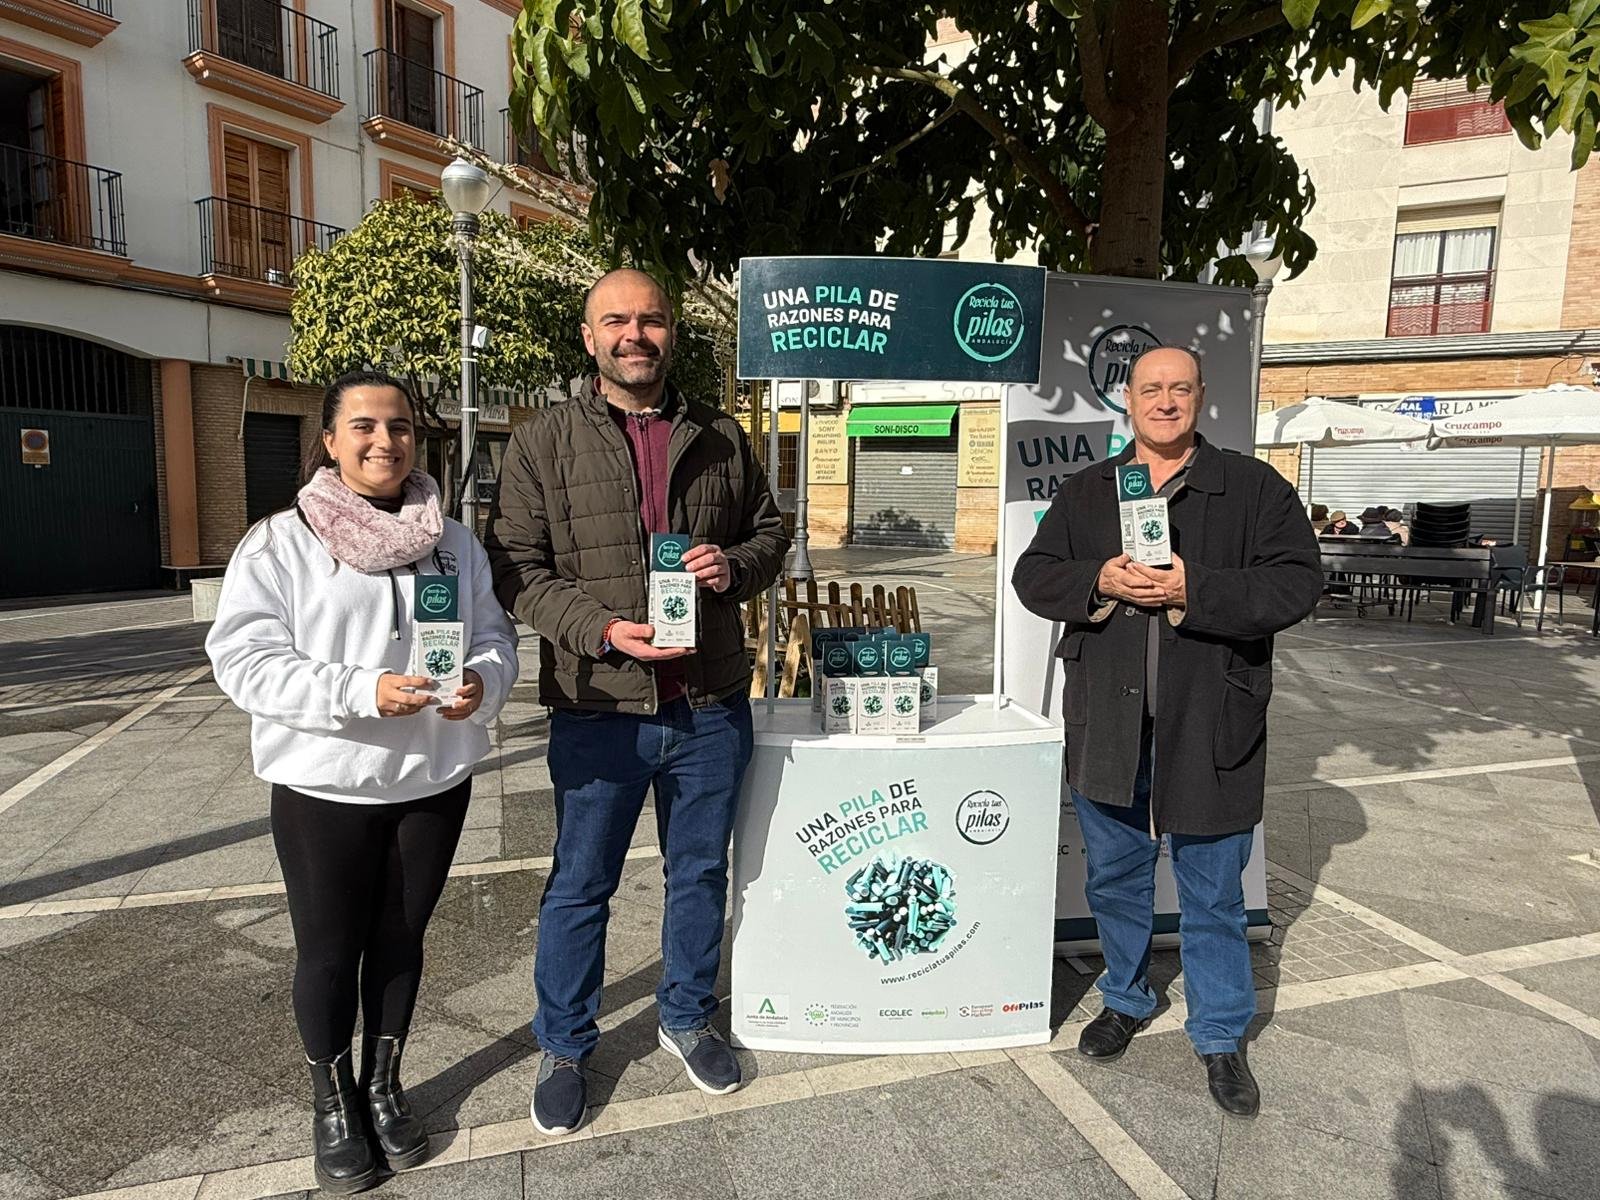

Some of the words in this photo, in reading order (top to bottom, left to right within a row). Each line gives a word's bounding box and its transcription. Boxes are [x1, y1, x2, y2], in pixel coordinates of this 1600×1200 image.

[763, 287, 809, 309] UNA
[815, 285, 862, 305] PILA
[868, 289, 899, 311] DE
[969, 296, 999, 308] Recicla
[1001, 298, 1014, 309] tus
[767, 307, 843, 329] RAZONES
[848, 309, 891, 330] PARA
[965, 309, 1014, 343] pilas
[770, 327, 888, 354] RECICLAR
[1105, 339, 1139, 352] Recicla
[1396, 402, 1422, 411] RAL
[874, 425, 919, 434] SONI-DISCO
[1444, 421, 1502, 430] Cruzcampo
[1017, 434, 1095, 468] UNA
[795, 811, 838, 844] UNA
[838, 789, 886, 818] PILA
[889, 779, 917, 799] DE
[965, 808, 1002, 833] pilas
[808, 811, 876, 857] RAZONES
[878, 797, 922, 819] PARA
[817, 811, 928, 875] RECICLAR
[881, 921, 981, 985] www.reciclatuspilas.com
[879, 1009, 913, 1017] ECOLEC
